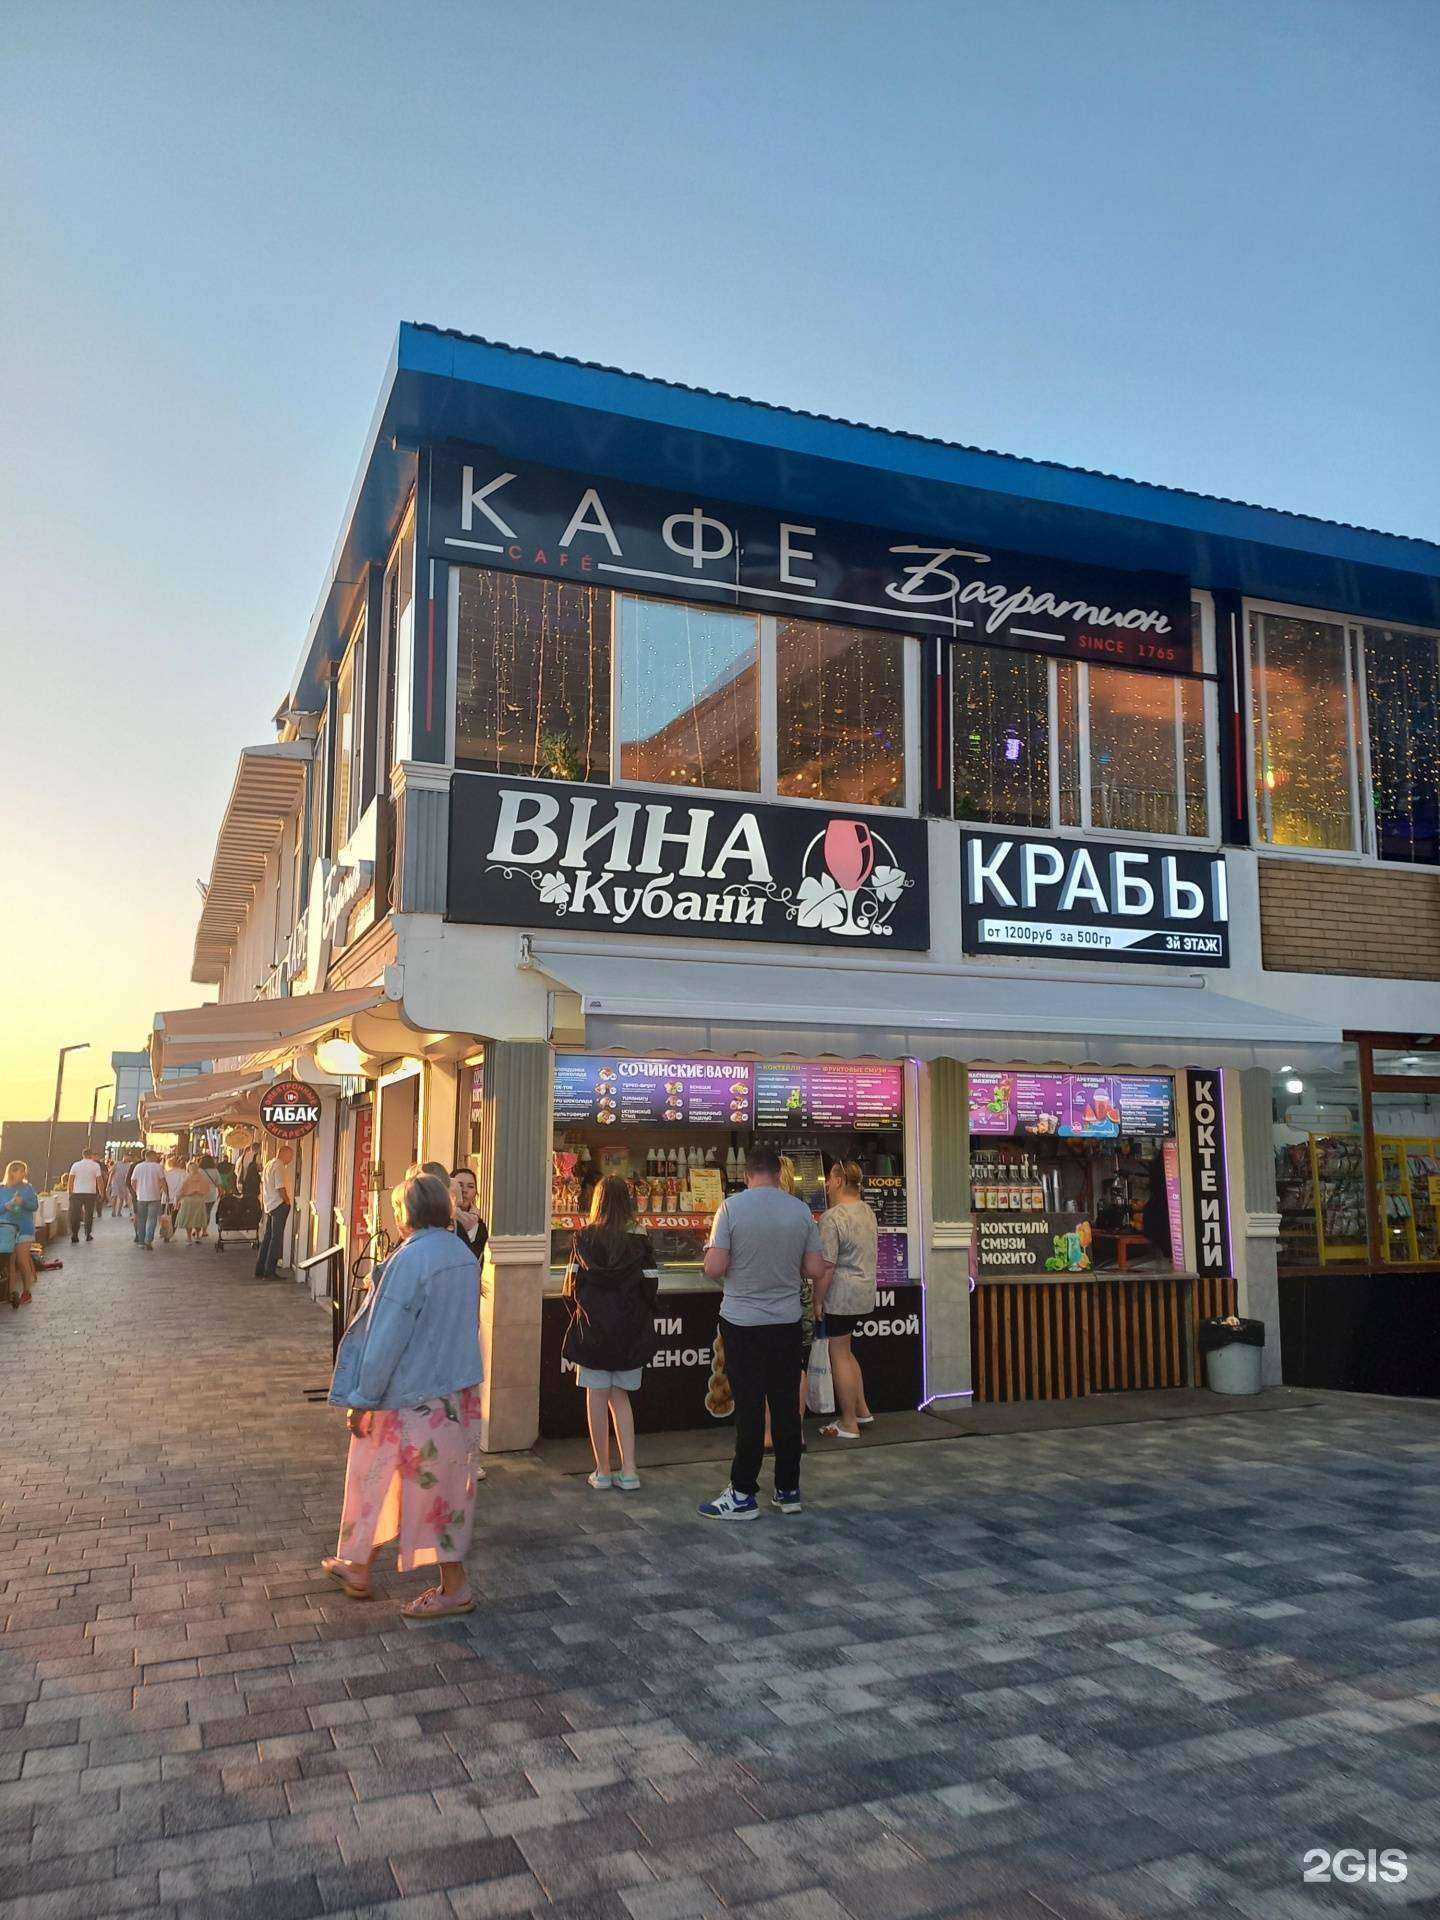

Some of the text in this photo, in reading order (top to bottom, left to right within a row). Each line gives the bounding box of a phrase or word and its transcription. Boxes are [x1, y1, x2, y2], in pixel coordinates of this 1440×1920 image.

[461, 465, 818, 588] КАФЕ
[885, 545, 1172, 634] Багратион
[1078, 635, 1175, 661] SINCE 1765
[486, 789, 773, 882] ВИНА
[967, 838, 1230, 922] КРАБЫ
[569, 870, 766, 924] Кубани
[987, 926, 1112, 947] от 1200руб за 500гр
[1183, 937, 1218, 952] ЭТАЖ
[618, 1063, 749, 1079] СОЧИНСКИЕ ВАФЛИ
[262, 1106, 319, 1122] ТАБАК
[868, 1178, 902, 1188] КОФЕ
[656, 1217, 689, 1227] 200
[981, 1237, 1026, 1250] СМУЗИ
[981, 1252, 1036, 1265] МОХИТО
